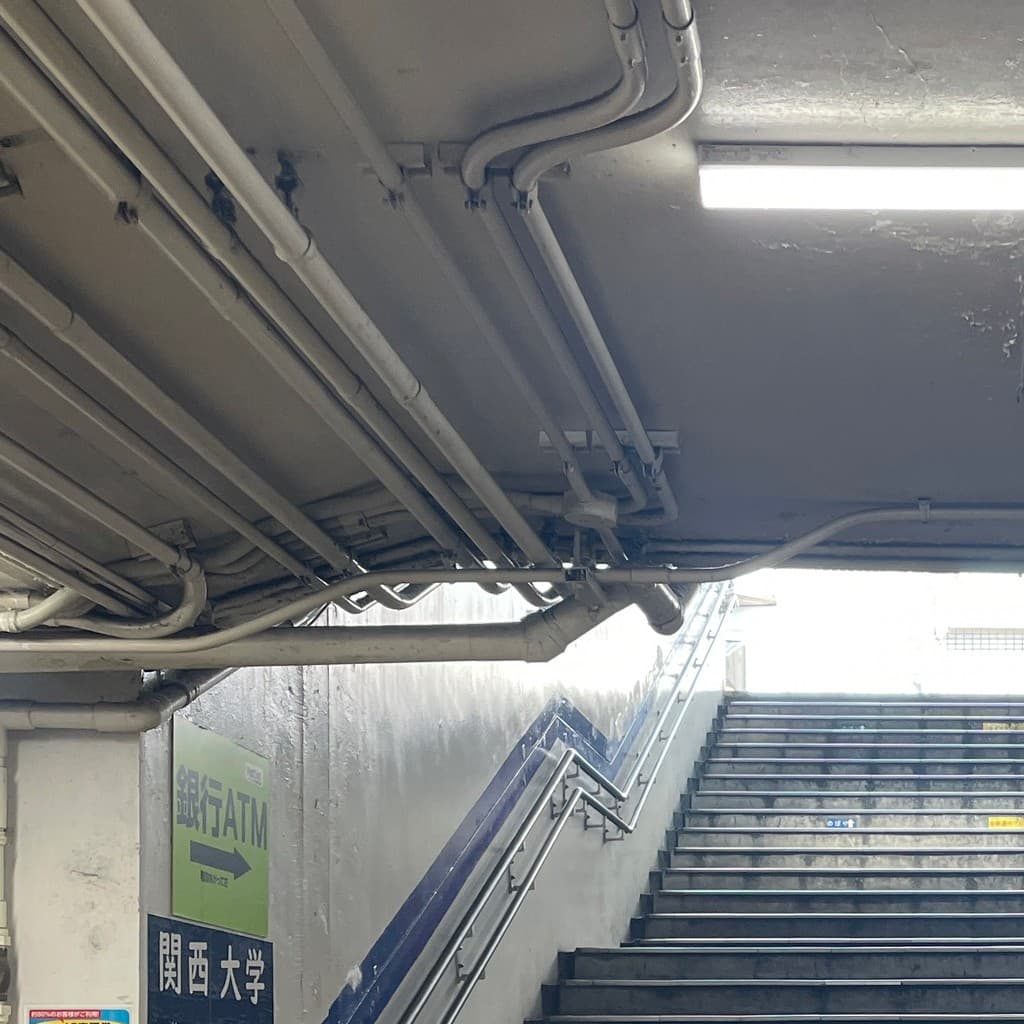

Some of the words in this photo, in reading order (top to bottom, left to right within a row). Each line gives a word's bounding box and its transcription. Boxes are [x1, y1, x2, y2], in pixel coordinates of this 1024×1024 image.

[176, 765, 267, 850] 銀行ATM
[160, 931, 265, 1005] 関西大学
